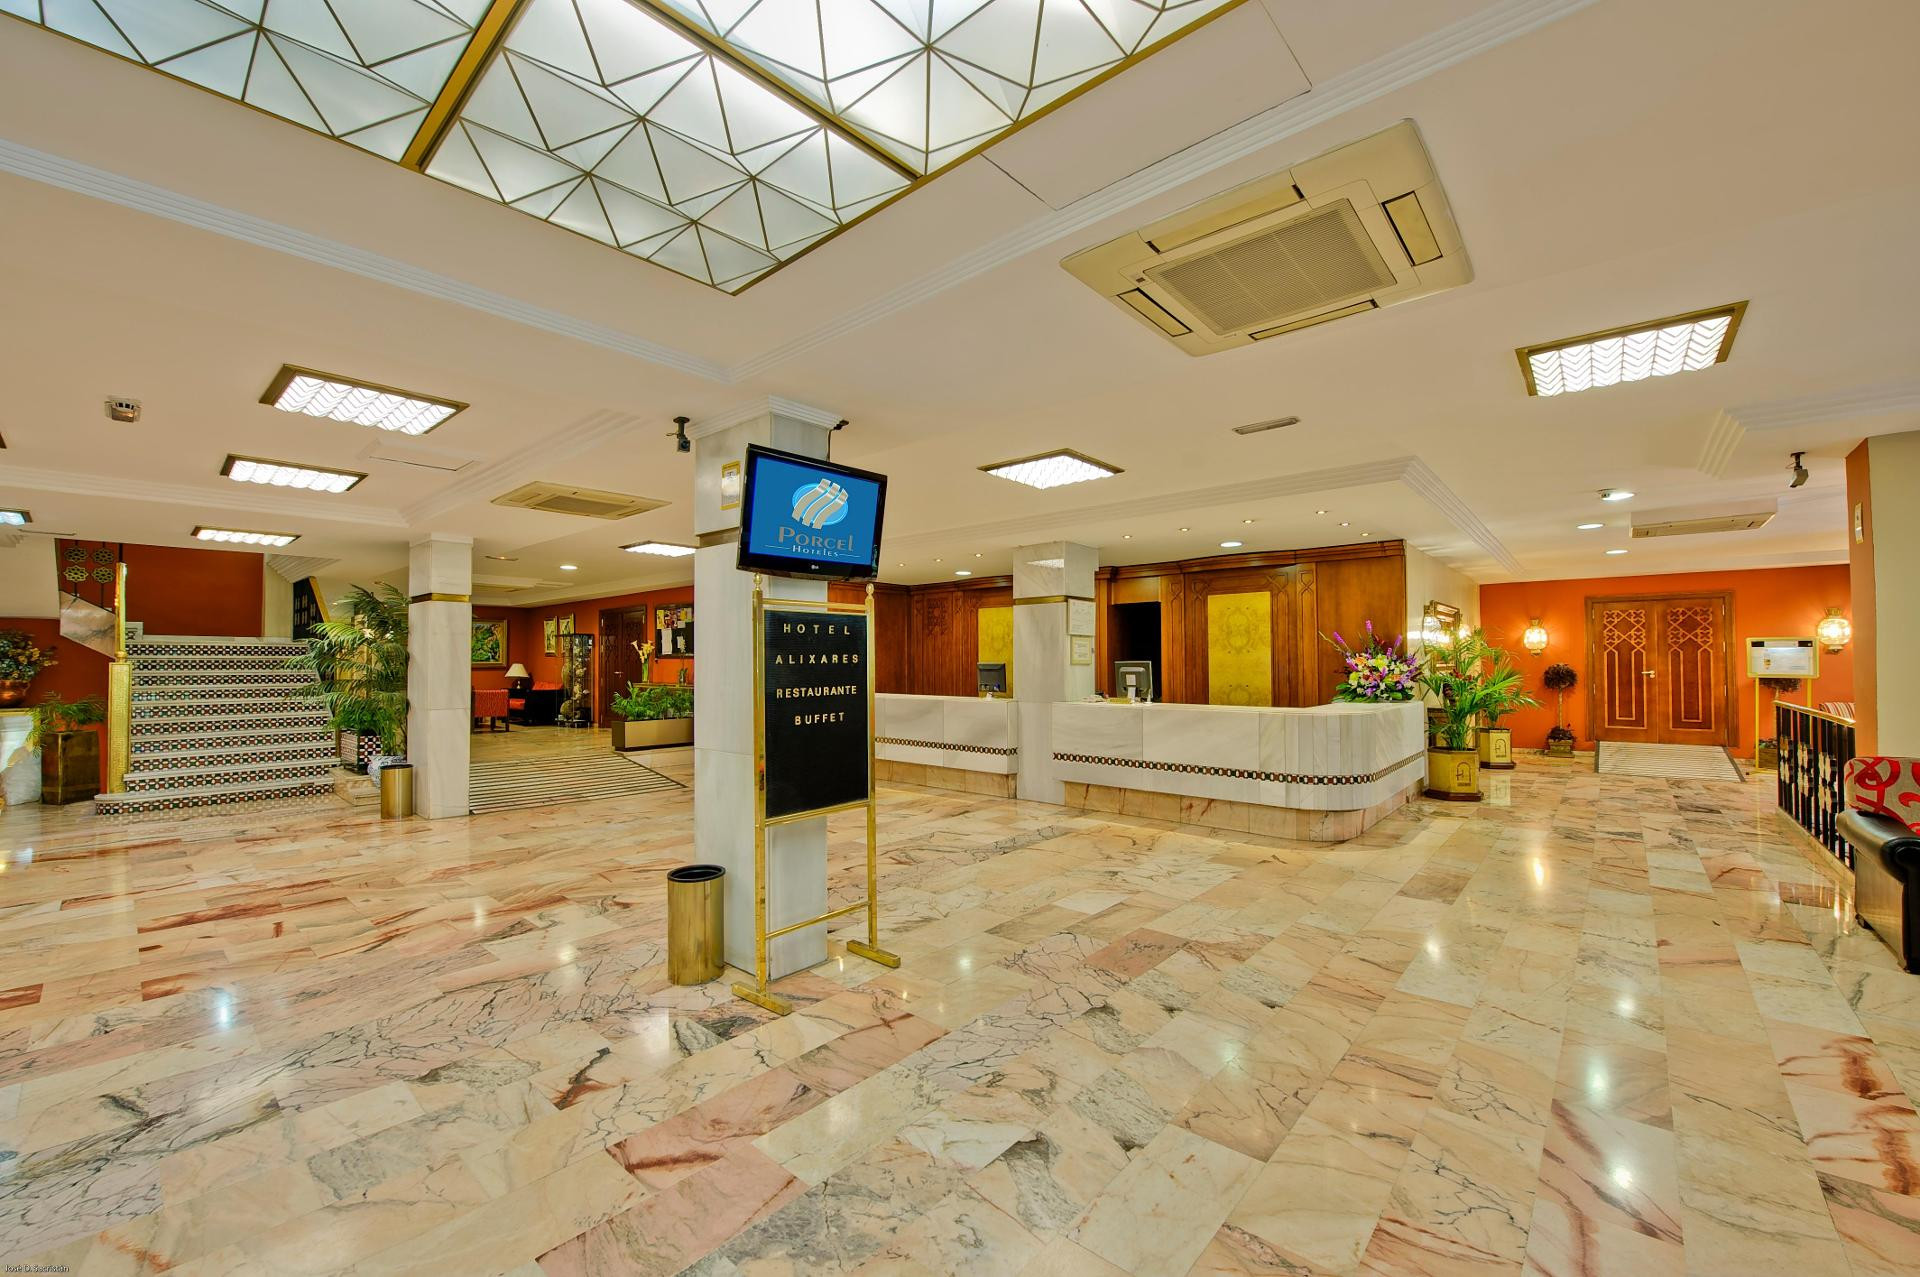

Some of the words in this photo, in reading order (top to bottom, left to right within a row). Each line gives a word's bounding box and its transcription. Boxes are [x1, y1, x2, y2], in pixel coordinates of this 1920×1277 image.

[783, 623, 850, 635] HOTEL
[775, 654, 859, 664] ALIXARES
[776, 686, 857, 698] RESTAURANTE
[794, 712, 845, 726] BUFFET
